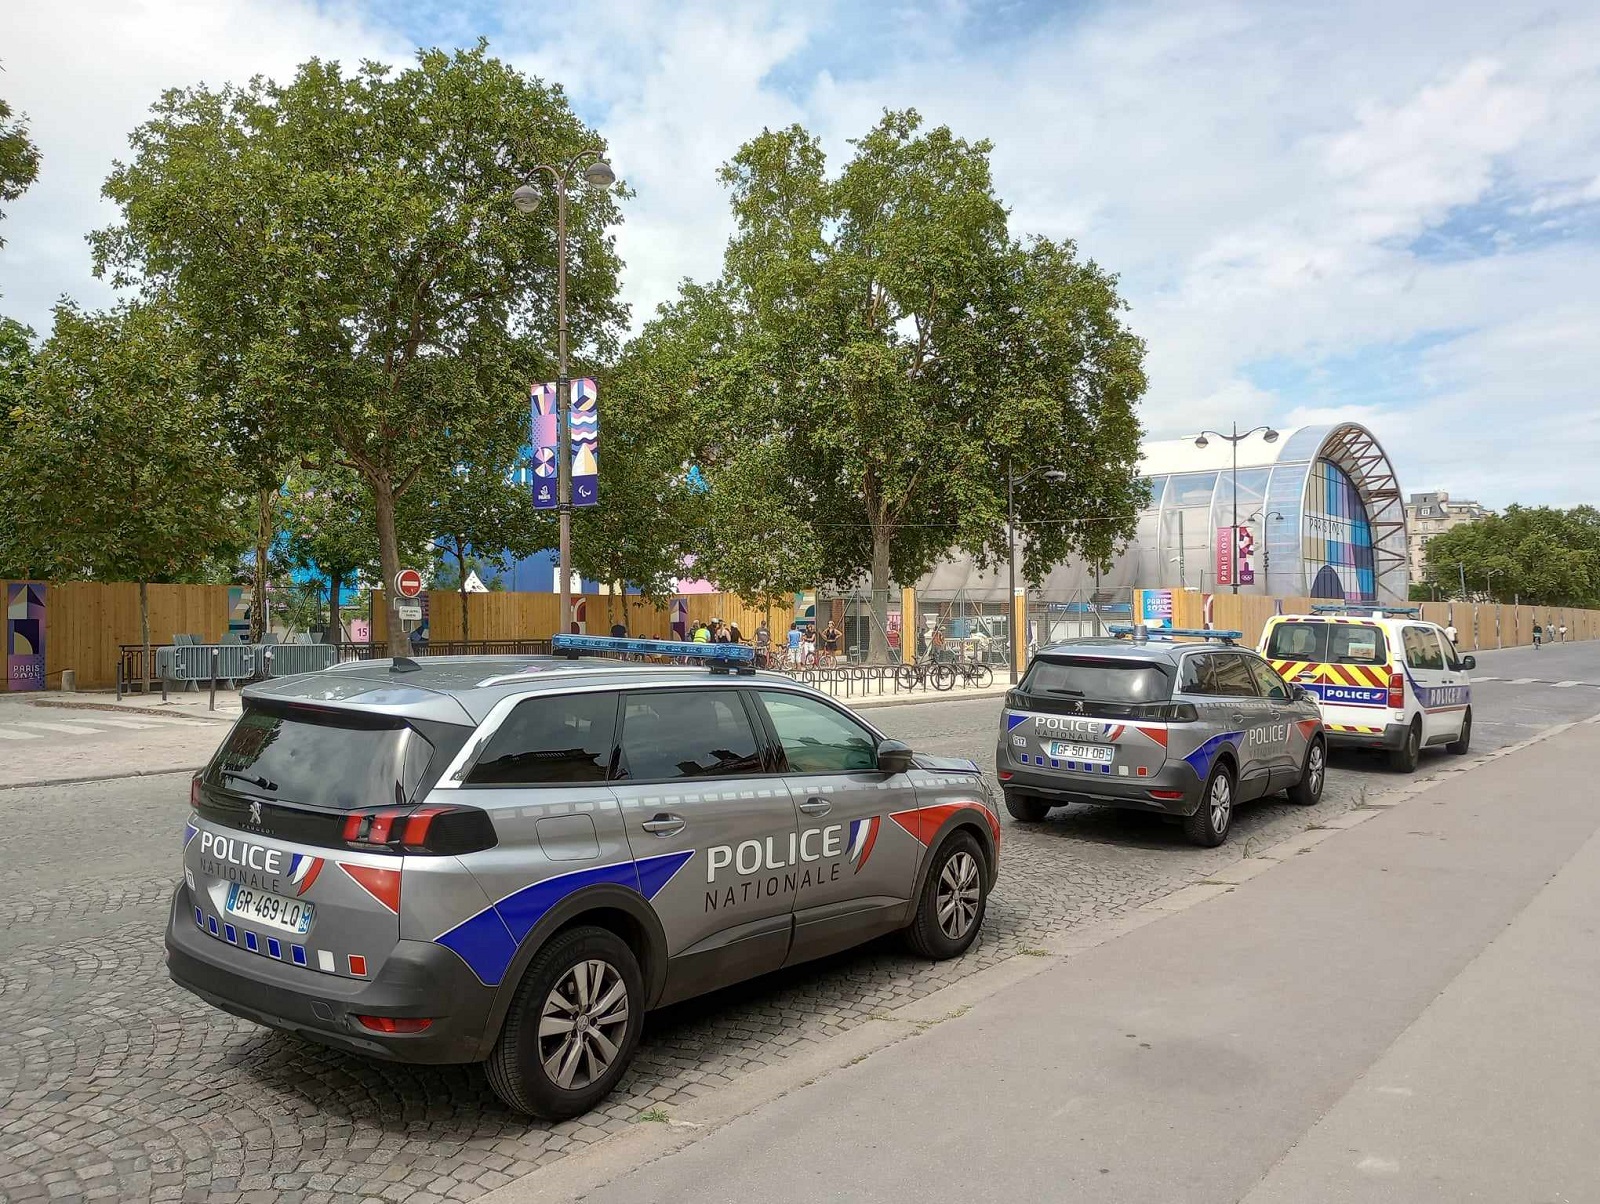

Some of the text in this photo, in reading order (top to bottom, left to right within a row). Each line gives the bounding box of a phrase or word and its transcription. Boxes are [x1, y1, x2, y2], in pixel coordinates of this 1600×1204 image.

[357, 627, 368, 637] 15
[13, 664, 40, 672] PARIS
[1327, 689, 1371, 700] POLICE
[1430, 688, 1457, 706] POLICE
[1034, 728, 1099, 742] NATIONALE
[1035, 716, 1100, 734] POLICE
[1249, 724, 1284, 747] POLICE
[200, 831, 282, 875] POLICE
[706, 823, 843, 884] POLICE
[200, 858, 281, 894] NATIONALE
[704, 862, 841, 914] NATIONALE
[235, 889, 301, 928] GR-469-LQ
